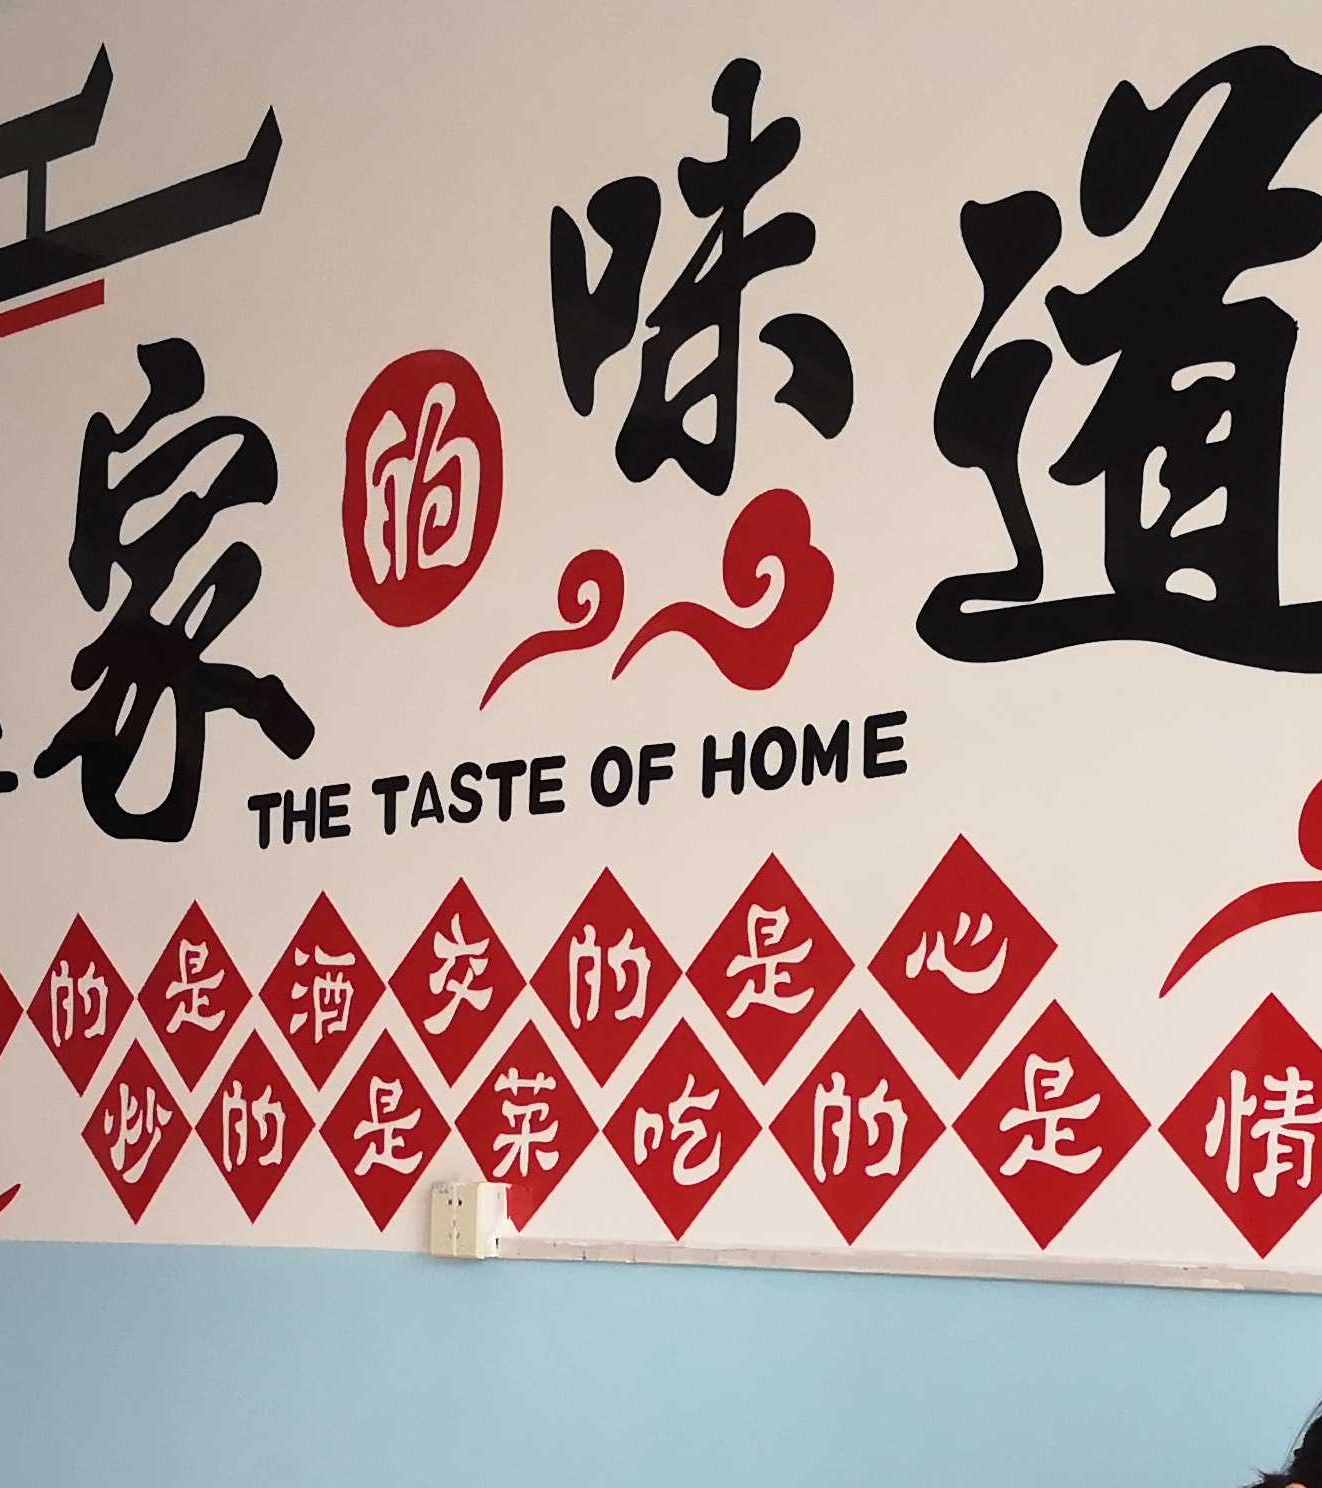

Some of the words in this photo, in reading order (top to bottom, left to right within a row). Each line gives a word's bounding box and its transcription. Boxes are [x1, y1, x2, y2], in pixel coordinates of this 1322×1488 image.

[247, 783, 351, 850] THE
[372, 755, 566, 836] TASTE
[590, 742, 676, 808] OF
[701, 710, 908, 799] HOME
